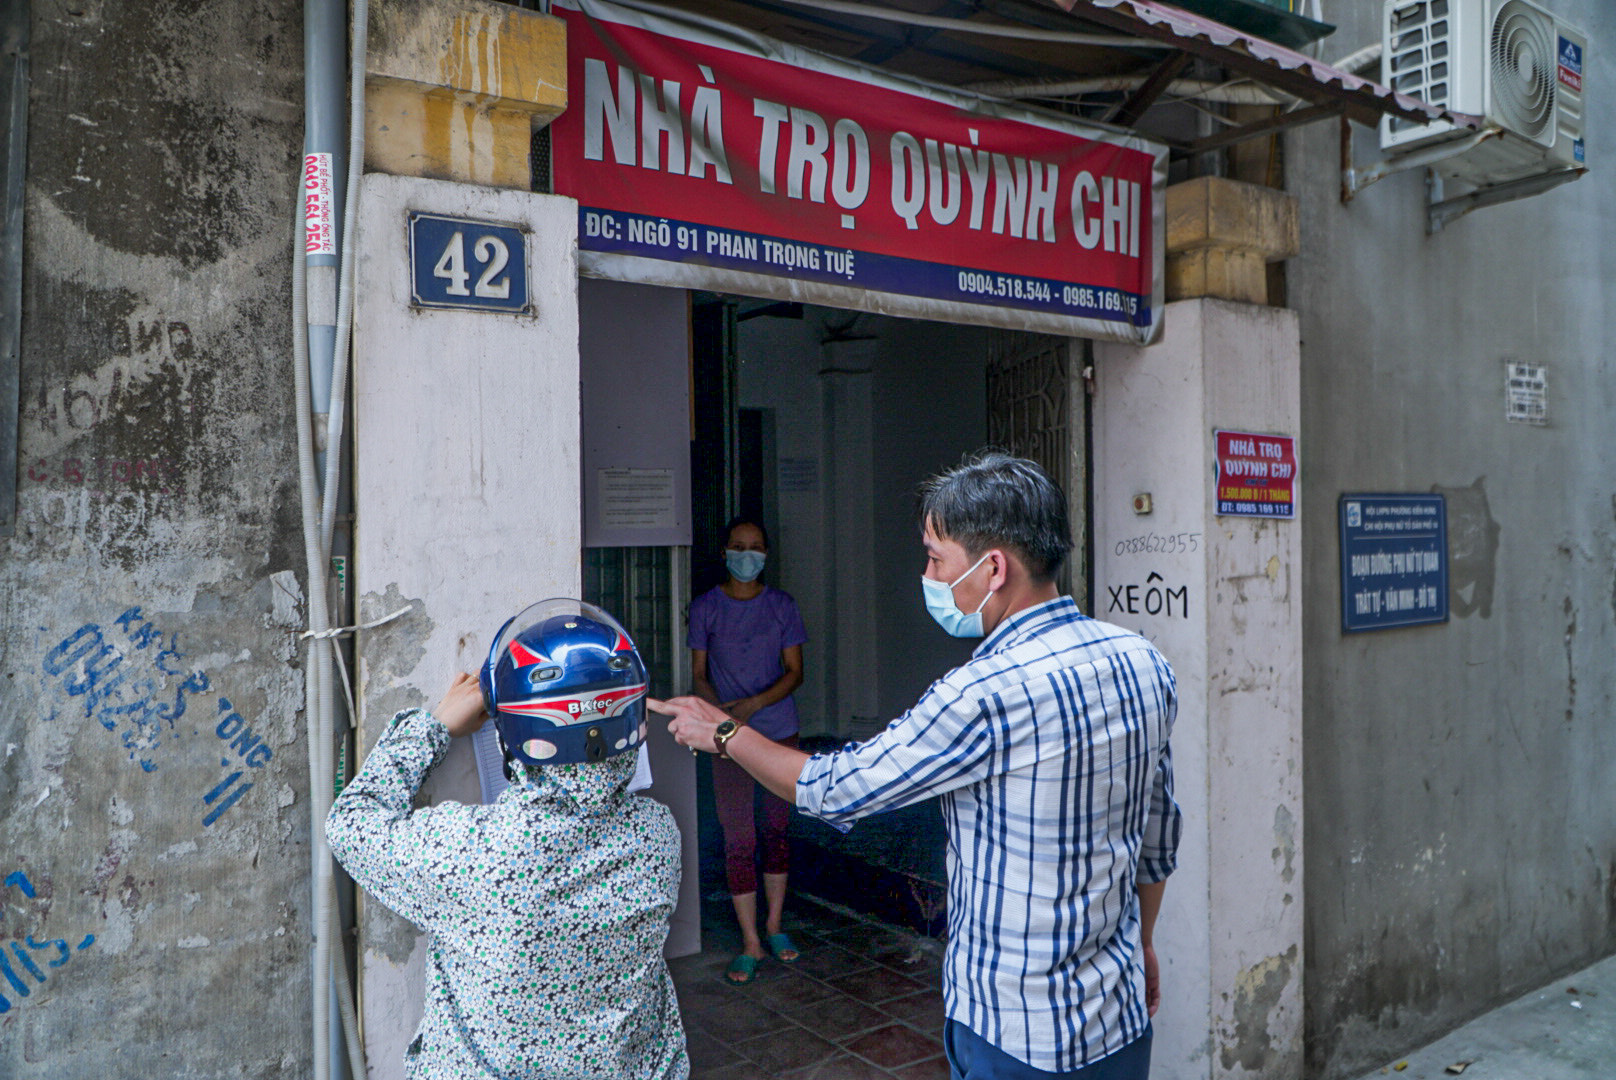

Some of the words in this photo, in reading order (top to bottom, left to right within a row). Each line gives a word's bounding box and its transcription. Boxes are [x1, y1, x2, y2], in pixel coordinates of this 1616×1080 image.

[584, 57, 733, 185] NHÀ
[753, 97, 871, 230] TRỌ
[890, 127, 1059, 243] QUỲNH
[1071, 170, 1141, 258] CHI
[585, 212, 622, 241] ĐC:
[628, 219, 671, 248] NGÕ
[677, 228, 699, 252] 91
[706, 231, 758, 261] PHAN
[762, 239, 821, 271] TRỌNG
[824, 249, 856, 280] TUỆ
[433, 231, 510, 299] 42
[958, 271, 1050, 302] 0904.518.544
[1229, 438, 1256, 457] NHÀ
[1258, 441, 1283, 462] TRỌ
[1271, 463, 1292, 479] CHI
[1236, 502, 1257, 513] 0985
[1108, 585, 1139, 614] XE
[1145, 571, 1188, 619] ÔM
[568, 698, 613, 714] BKtec
